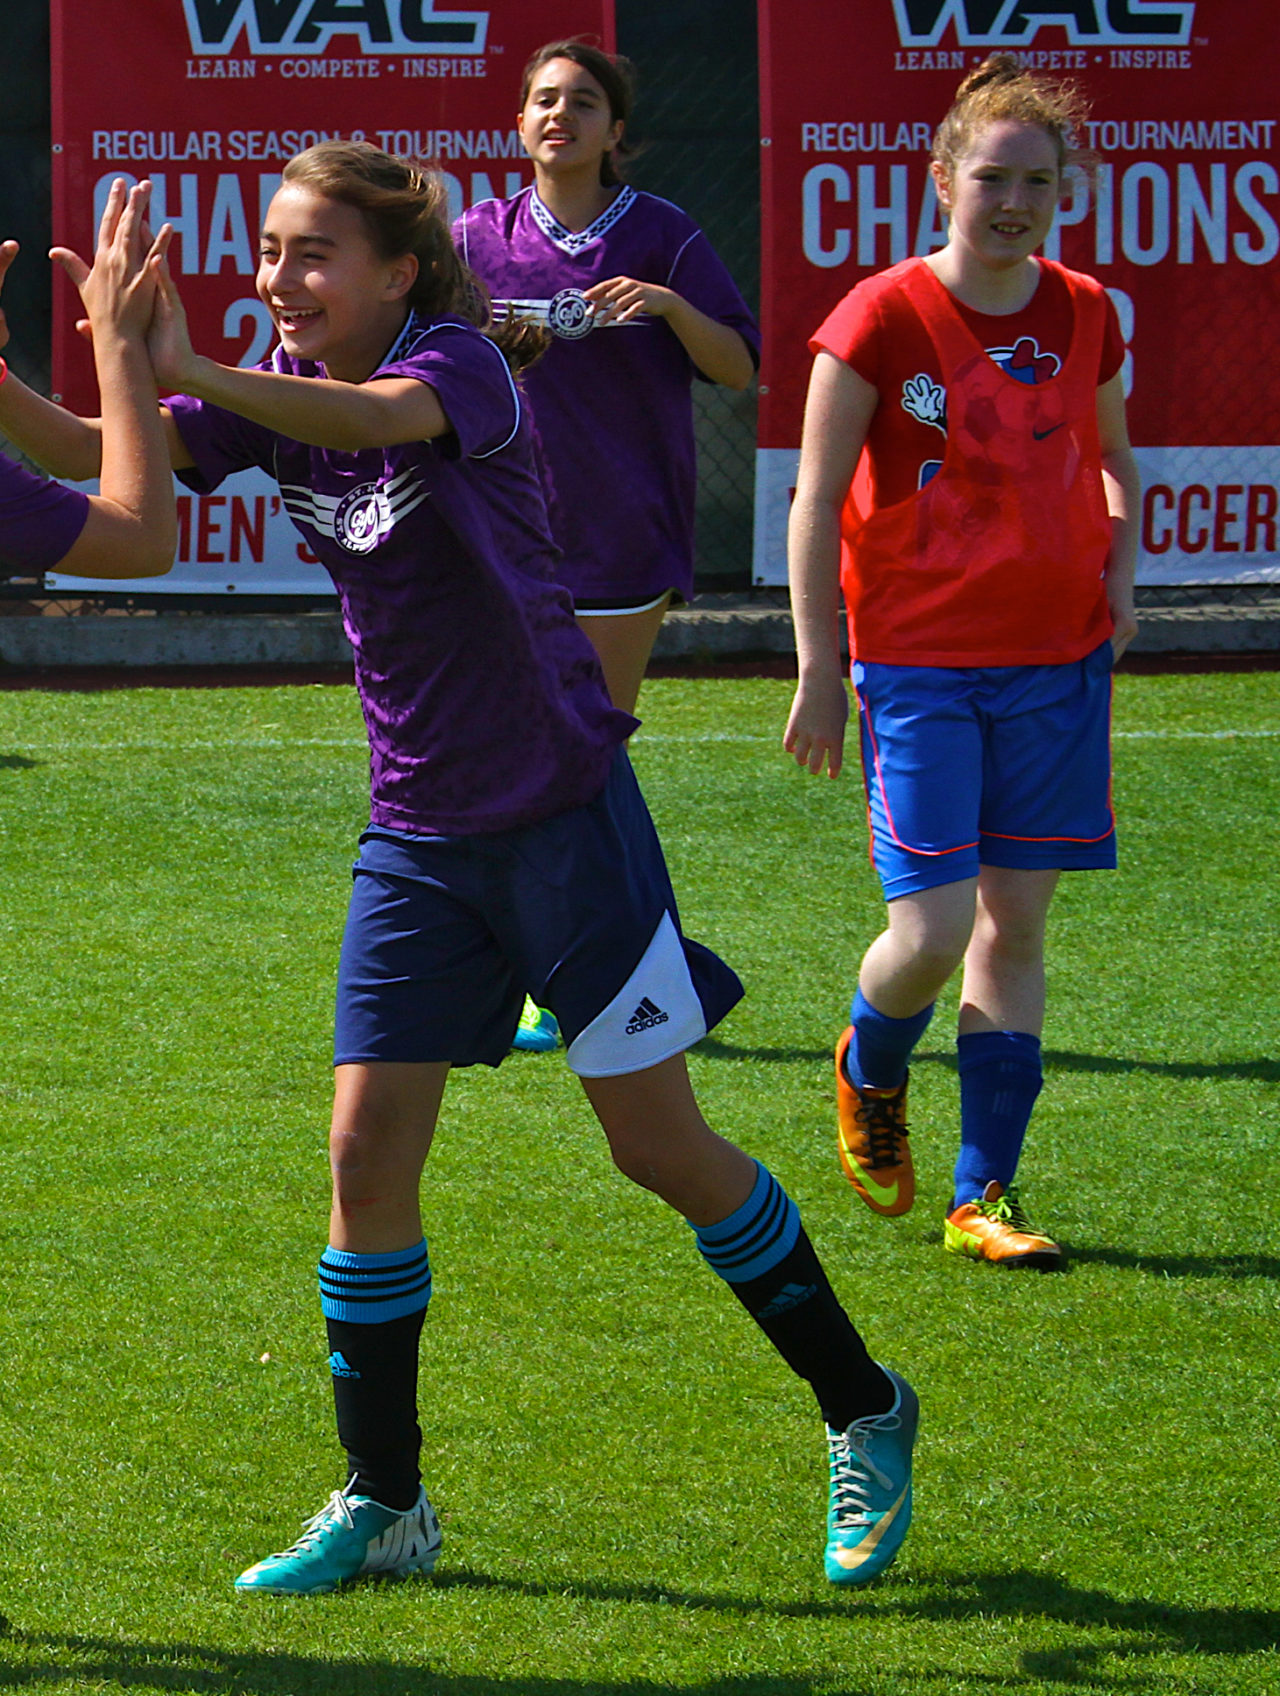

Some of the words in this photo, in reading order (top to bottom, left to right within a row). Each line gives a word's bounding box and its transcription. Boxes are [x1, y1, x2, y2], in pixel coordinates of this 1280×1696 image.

[186, 59, 256, 78] LEARN
[279, 59, 380, 78] COMPETE
[403, 58, 487, 77] INSPIRE
[894, 51, 965, 70] LEARN
[1109, 50, 1191, 68] INSPIRE
[92, 130, 220, 160] REGULAR
[801, 122, 932, 151] REGULAR
[1083, 120, 1276, 150] TOURNAMENT
[802, 160, 1280, 269] CHAPIONS
[625, 1011, 669, 1035] adidas
